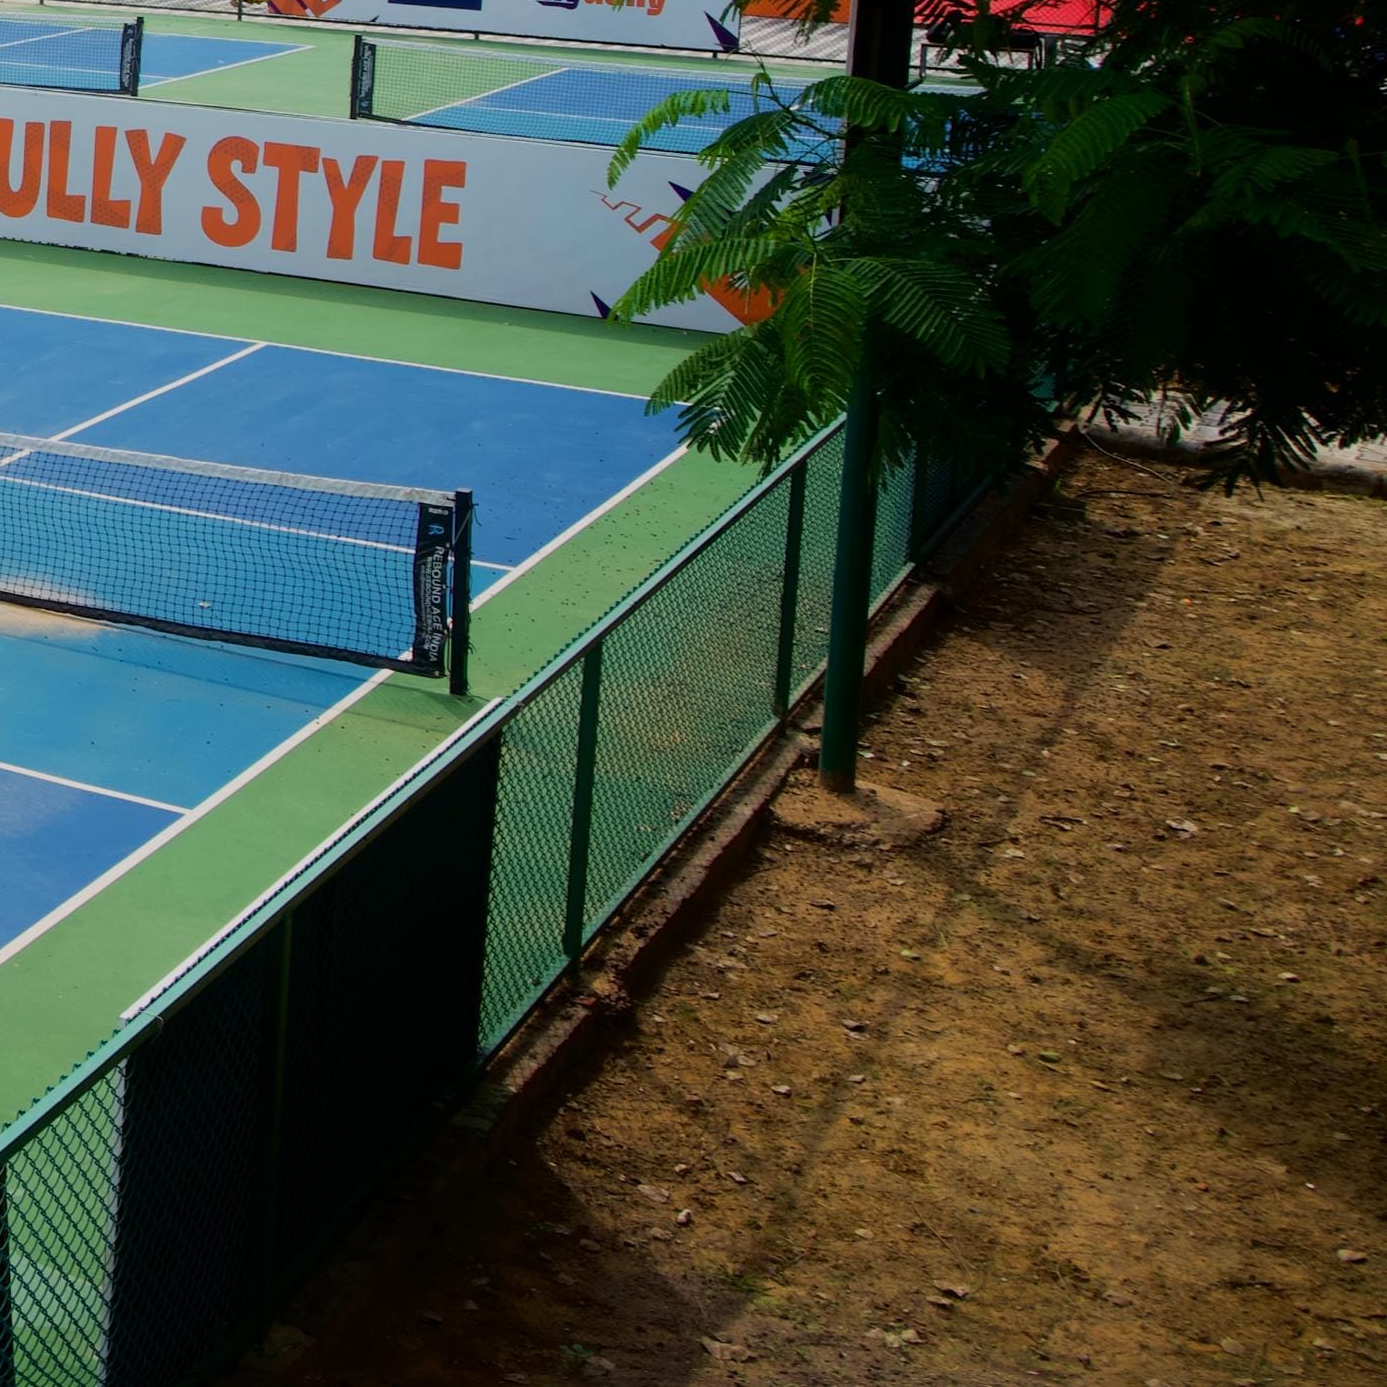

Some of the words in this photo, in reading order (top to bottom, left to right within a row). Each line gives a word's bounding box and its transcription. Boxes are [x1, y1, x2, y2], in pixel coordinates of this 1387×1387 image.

[201, 135, 466, 270] STYLE
[430, 545, 445, 604] REBOUND
[429, 631, 444, 662] INDIA
